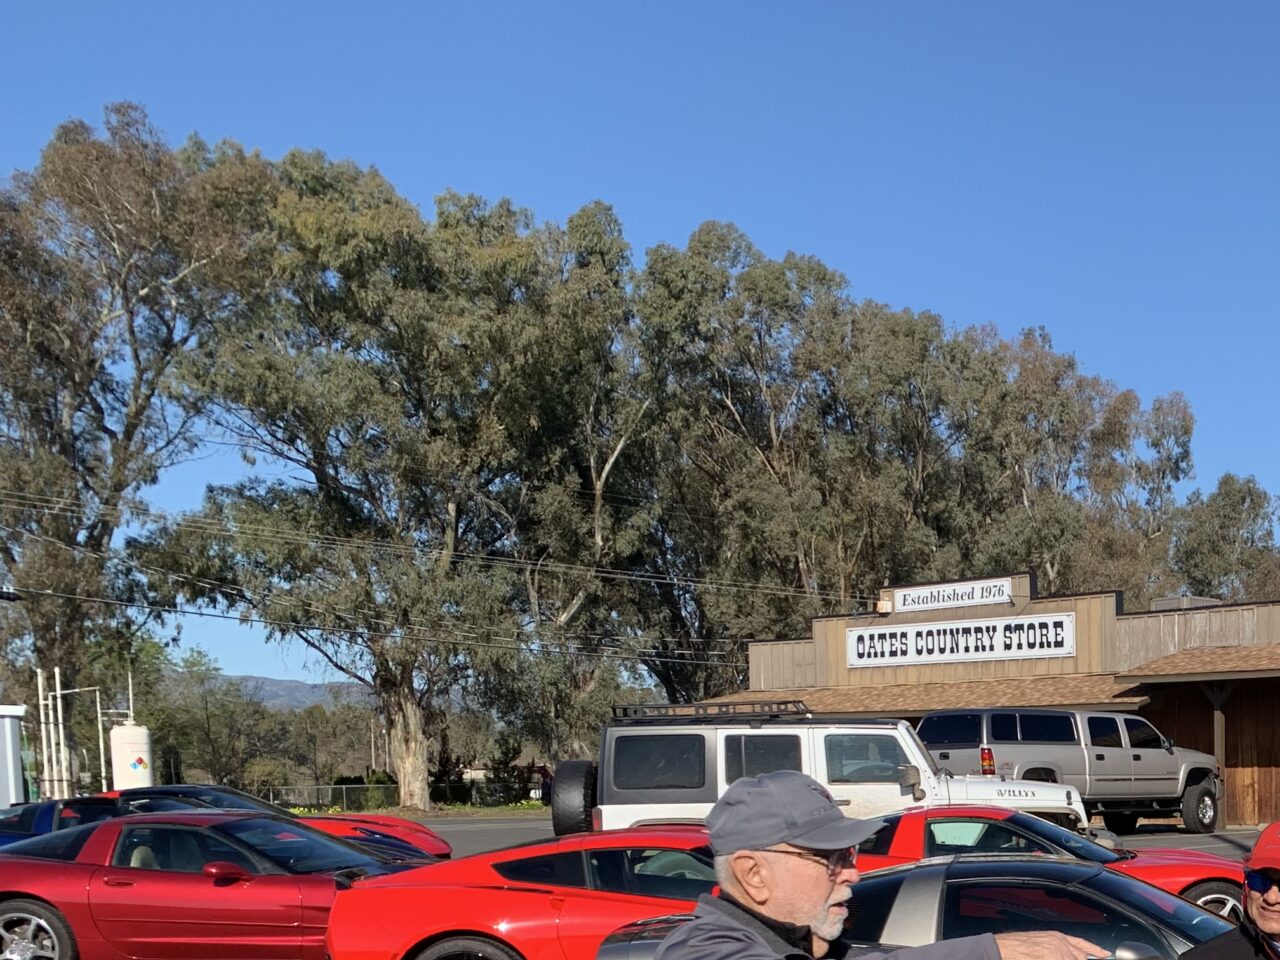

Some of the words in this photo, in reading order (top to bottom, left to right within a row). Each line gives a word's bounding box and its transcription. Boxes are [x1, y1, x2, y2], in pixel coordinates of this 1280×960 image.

[902, 588, 975, 607] Established
[980, 584, 1005, 599] 1976
[856, 631, 909, 659] OATES
[915, 625, 998, 656] COUNTRY
[1003, 621, 1065, 651] STORE
[996, 788, 1036, 797] WILLYS
